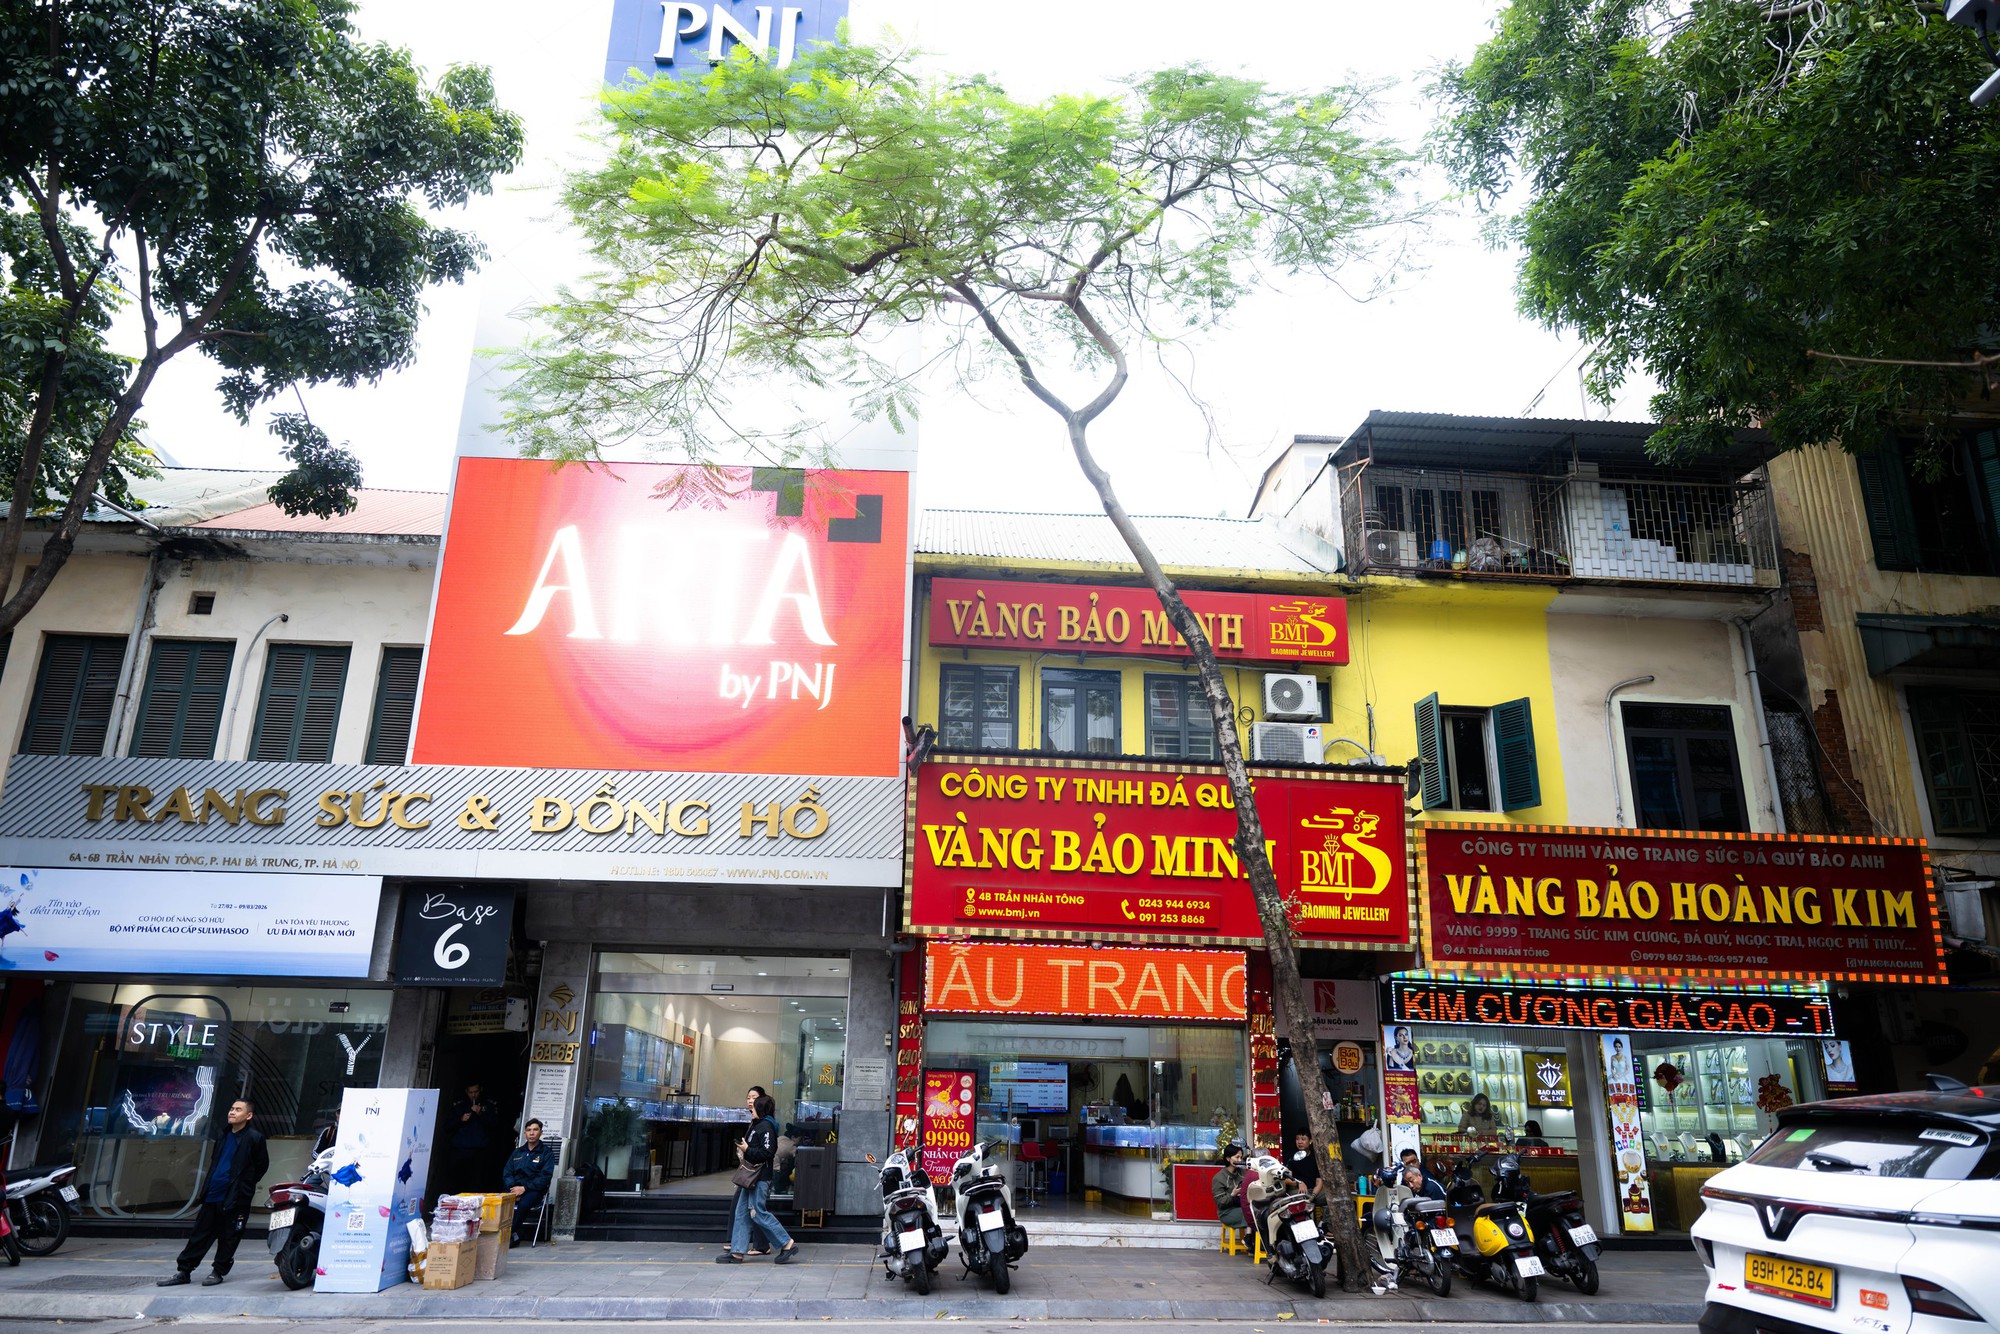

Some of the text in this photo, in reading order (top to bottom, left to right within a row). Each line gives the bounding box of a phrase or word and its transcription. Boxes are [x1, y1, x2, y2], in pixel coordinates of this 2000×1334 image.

[653, 1, 803, 70] PNJ
[946, 589, 1047, 641] VÀNG
[1057, 592, 1131, 645] BẢO
[1301, 649, 1335, 658] JEWELLERY
[719, 661, 837, 711] by PNJ
[940, 767, 1257, 810] CÔNG TY TNHH ĐÁ QU
[81, 777, 831, 839] TRANG SỨC & ĐỒNG HỒ
[922, 811, 1044, 871] VÀNG
[1049, 812, 1145, 875] BẢO
[106, 850, 361, 871] TRẦN NHÂN TÔNG, P. HAI BÀ TRƯNG, TP. HÀ NỘI
[1461, 837, 1885, 869] CÔNG TY TNHH VÀNG TRANG SỨC ĐÁ QUÝ BẢO ANH
[609, 865, 659, 876] HOTLINE:
[727, 869, 829, 880] WWW.PNJ.COM.VN
[65, 899, 82, 908] vào
[978, 889, 1085, 905] 4B TRẦN NHÂN TÔNG
[1138, 898, 1211, 910] 0243 944 6934
[1443, 864, 1918, 928] VÀNG BẢO HOÀNG KIM
[419, 893, 498, 925] Base
[978, 907, 1040, 919] www.bmj.vn
[1302, 904, 1390, 921] BAOMINH JEWELLERY
[1139, 913, 1205, 924] 091 253 8868
[109, 924, 121, 934] BỘ
[161, 926, 179, 934] CAO
[197, 926, 249, 935] SULWHASOO
[318, 929, 335, 938] BẠN
[1446, 922, 1481, 937] VÀNG
[1486, 926, 1518, 938] 9999
[1529, 928, 1570, 940] TRANG
[1574, 925, 1599, 941] SỨC
[1604, 930, 1629, 942] KIM
[1633, 931, 1681, 945] CƯƠNG,
[1684, 929, 1702, 944] ĐÁ
[1704, 931, 1733, 947] QUÝ,
[1736, 933, 1771, 950] NGỌC
[1808, 936, 1843, 950] NGỌC
[434, 923, 470, 970] 6
[1453, 944, 1550, 957] 4A TRẦN NHÂN TÔNG
[1643, 953, 1665, 961] 0979
[1667, 953, 1684, 961] 867
[1746, 956, 1768, 964] 4102
[926, 946, 1024, 1008] ẪU
[1403, 991, 1466, 1021] KIM
[1477, 992, 1618, 1027] CƯƠNG
[1628, 993, 1692, 1031] GIÁ
[1699, 1002, 1776, 1033] CAO
[540, 1010, 579, 1036] PNJ
[900, 1020, 919, 1038] SỨC
[130, 1022, 219, 1046] STYLE
[898, 1049, 918, 1065] CAO
[818, 1074, 835, 1086] PNJ
[365, 1107, 380, 1116] PNJ
[932, 1117, 965, 1129] VÀNG
[926, 1130, 970, 1147] 9999
[924, 1148, 948, 1159] NHẪN
[924, 1160, 950, 1174] Trang
